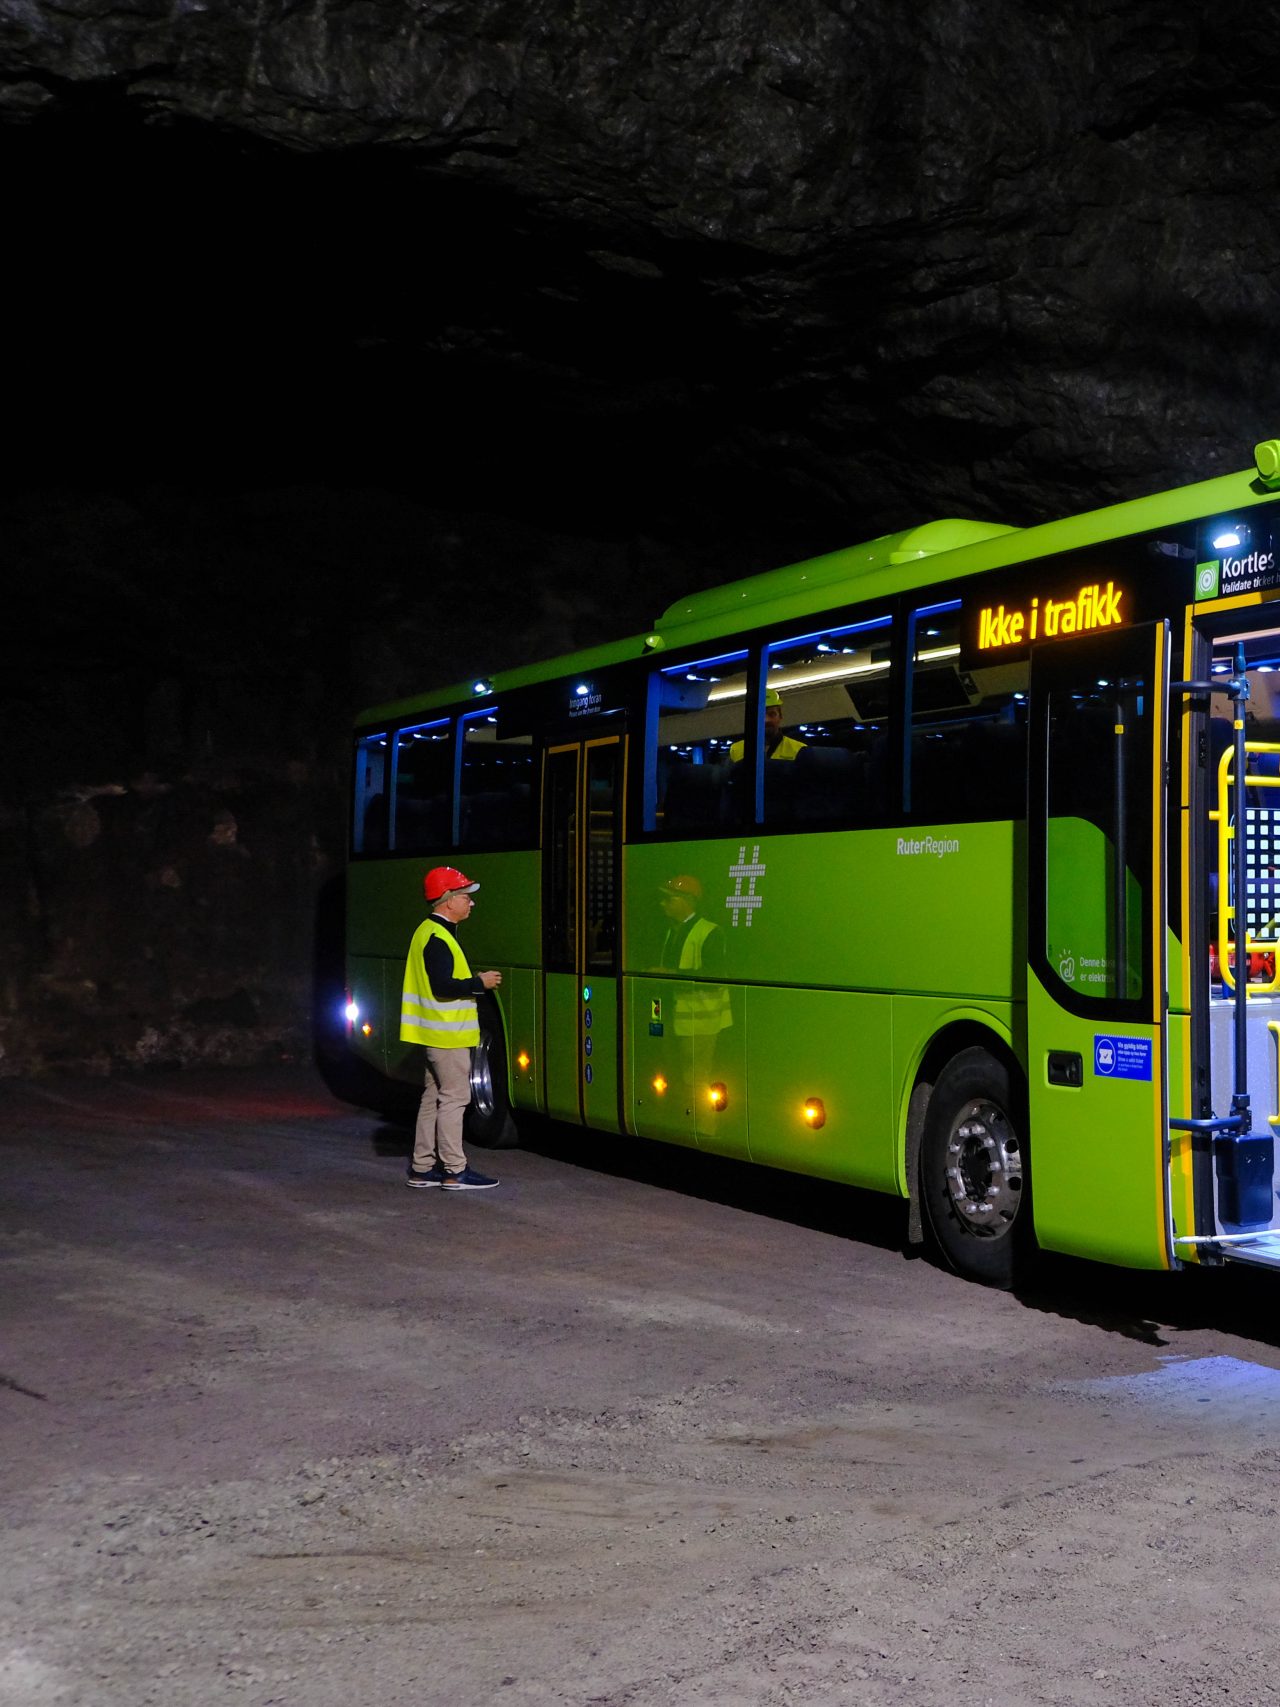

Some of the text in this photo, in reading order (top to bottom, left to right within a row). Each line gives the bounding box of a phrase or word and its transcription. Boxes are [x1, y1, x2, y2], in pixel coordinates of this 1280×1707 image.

[1222, 580, 1251, 594] Validate
[1253, 576, 1275, 588] ticket
[978, 581, 1123, 650] Ikke i trafikk
[897, 836, 959, 858] RuterRegion
[1080, 956, 1100, 967] Denne
[1080, 973, 1087, 982] er
